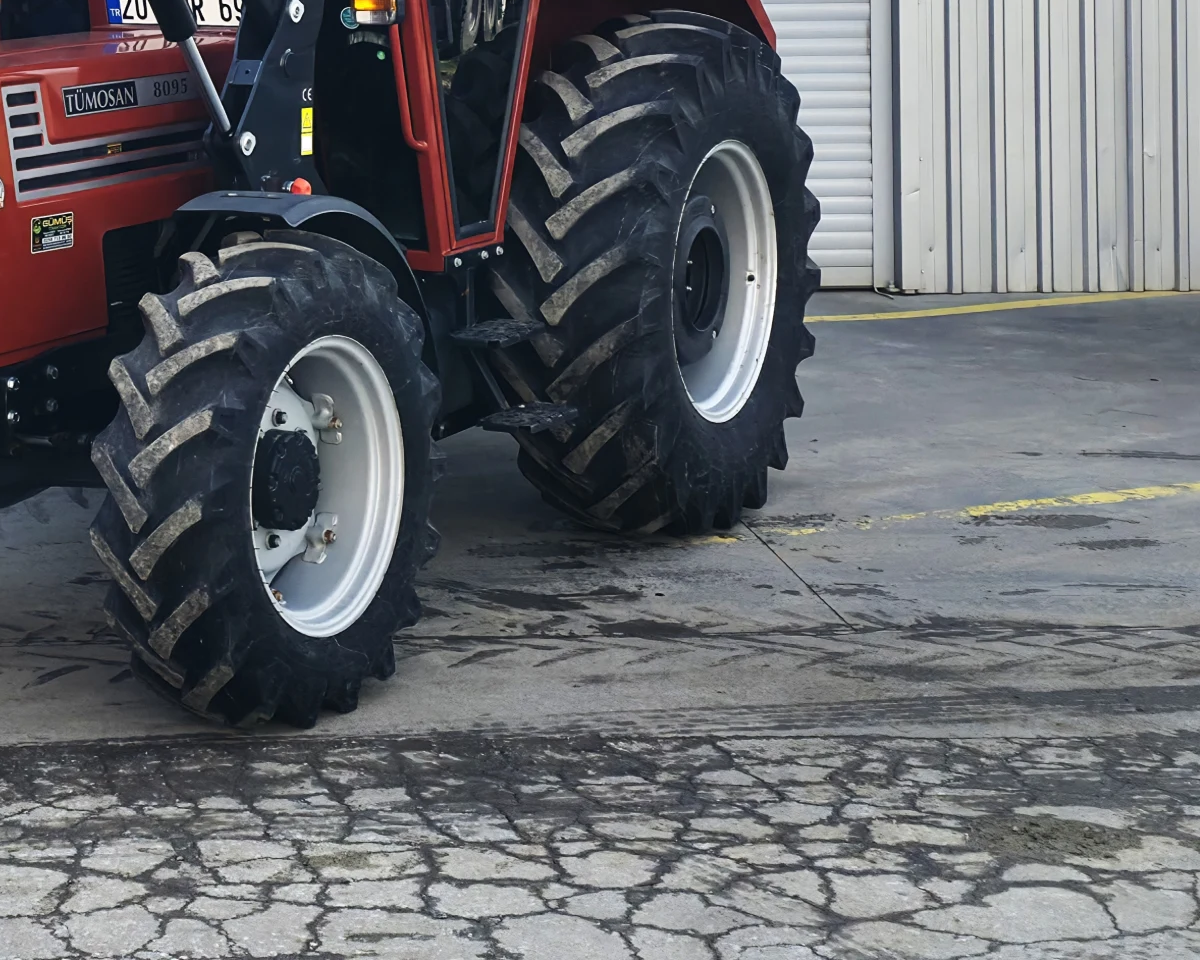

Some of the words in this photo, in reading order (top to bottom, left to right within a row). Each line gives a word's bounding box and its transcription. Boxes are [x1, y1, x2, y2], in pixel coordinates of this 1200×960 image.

[110, 8, 121, 17] TR
[66, 86, 134, 113] TÜMOSAN
[153, 78, 188, 98] 8095
[302, 88, 312, 101] CE
